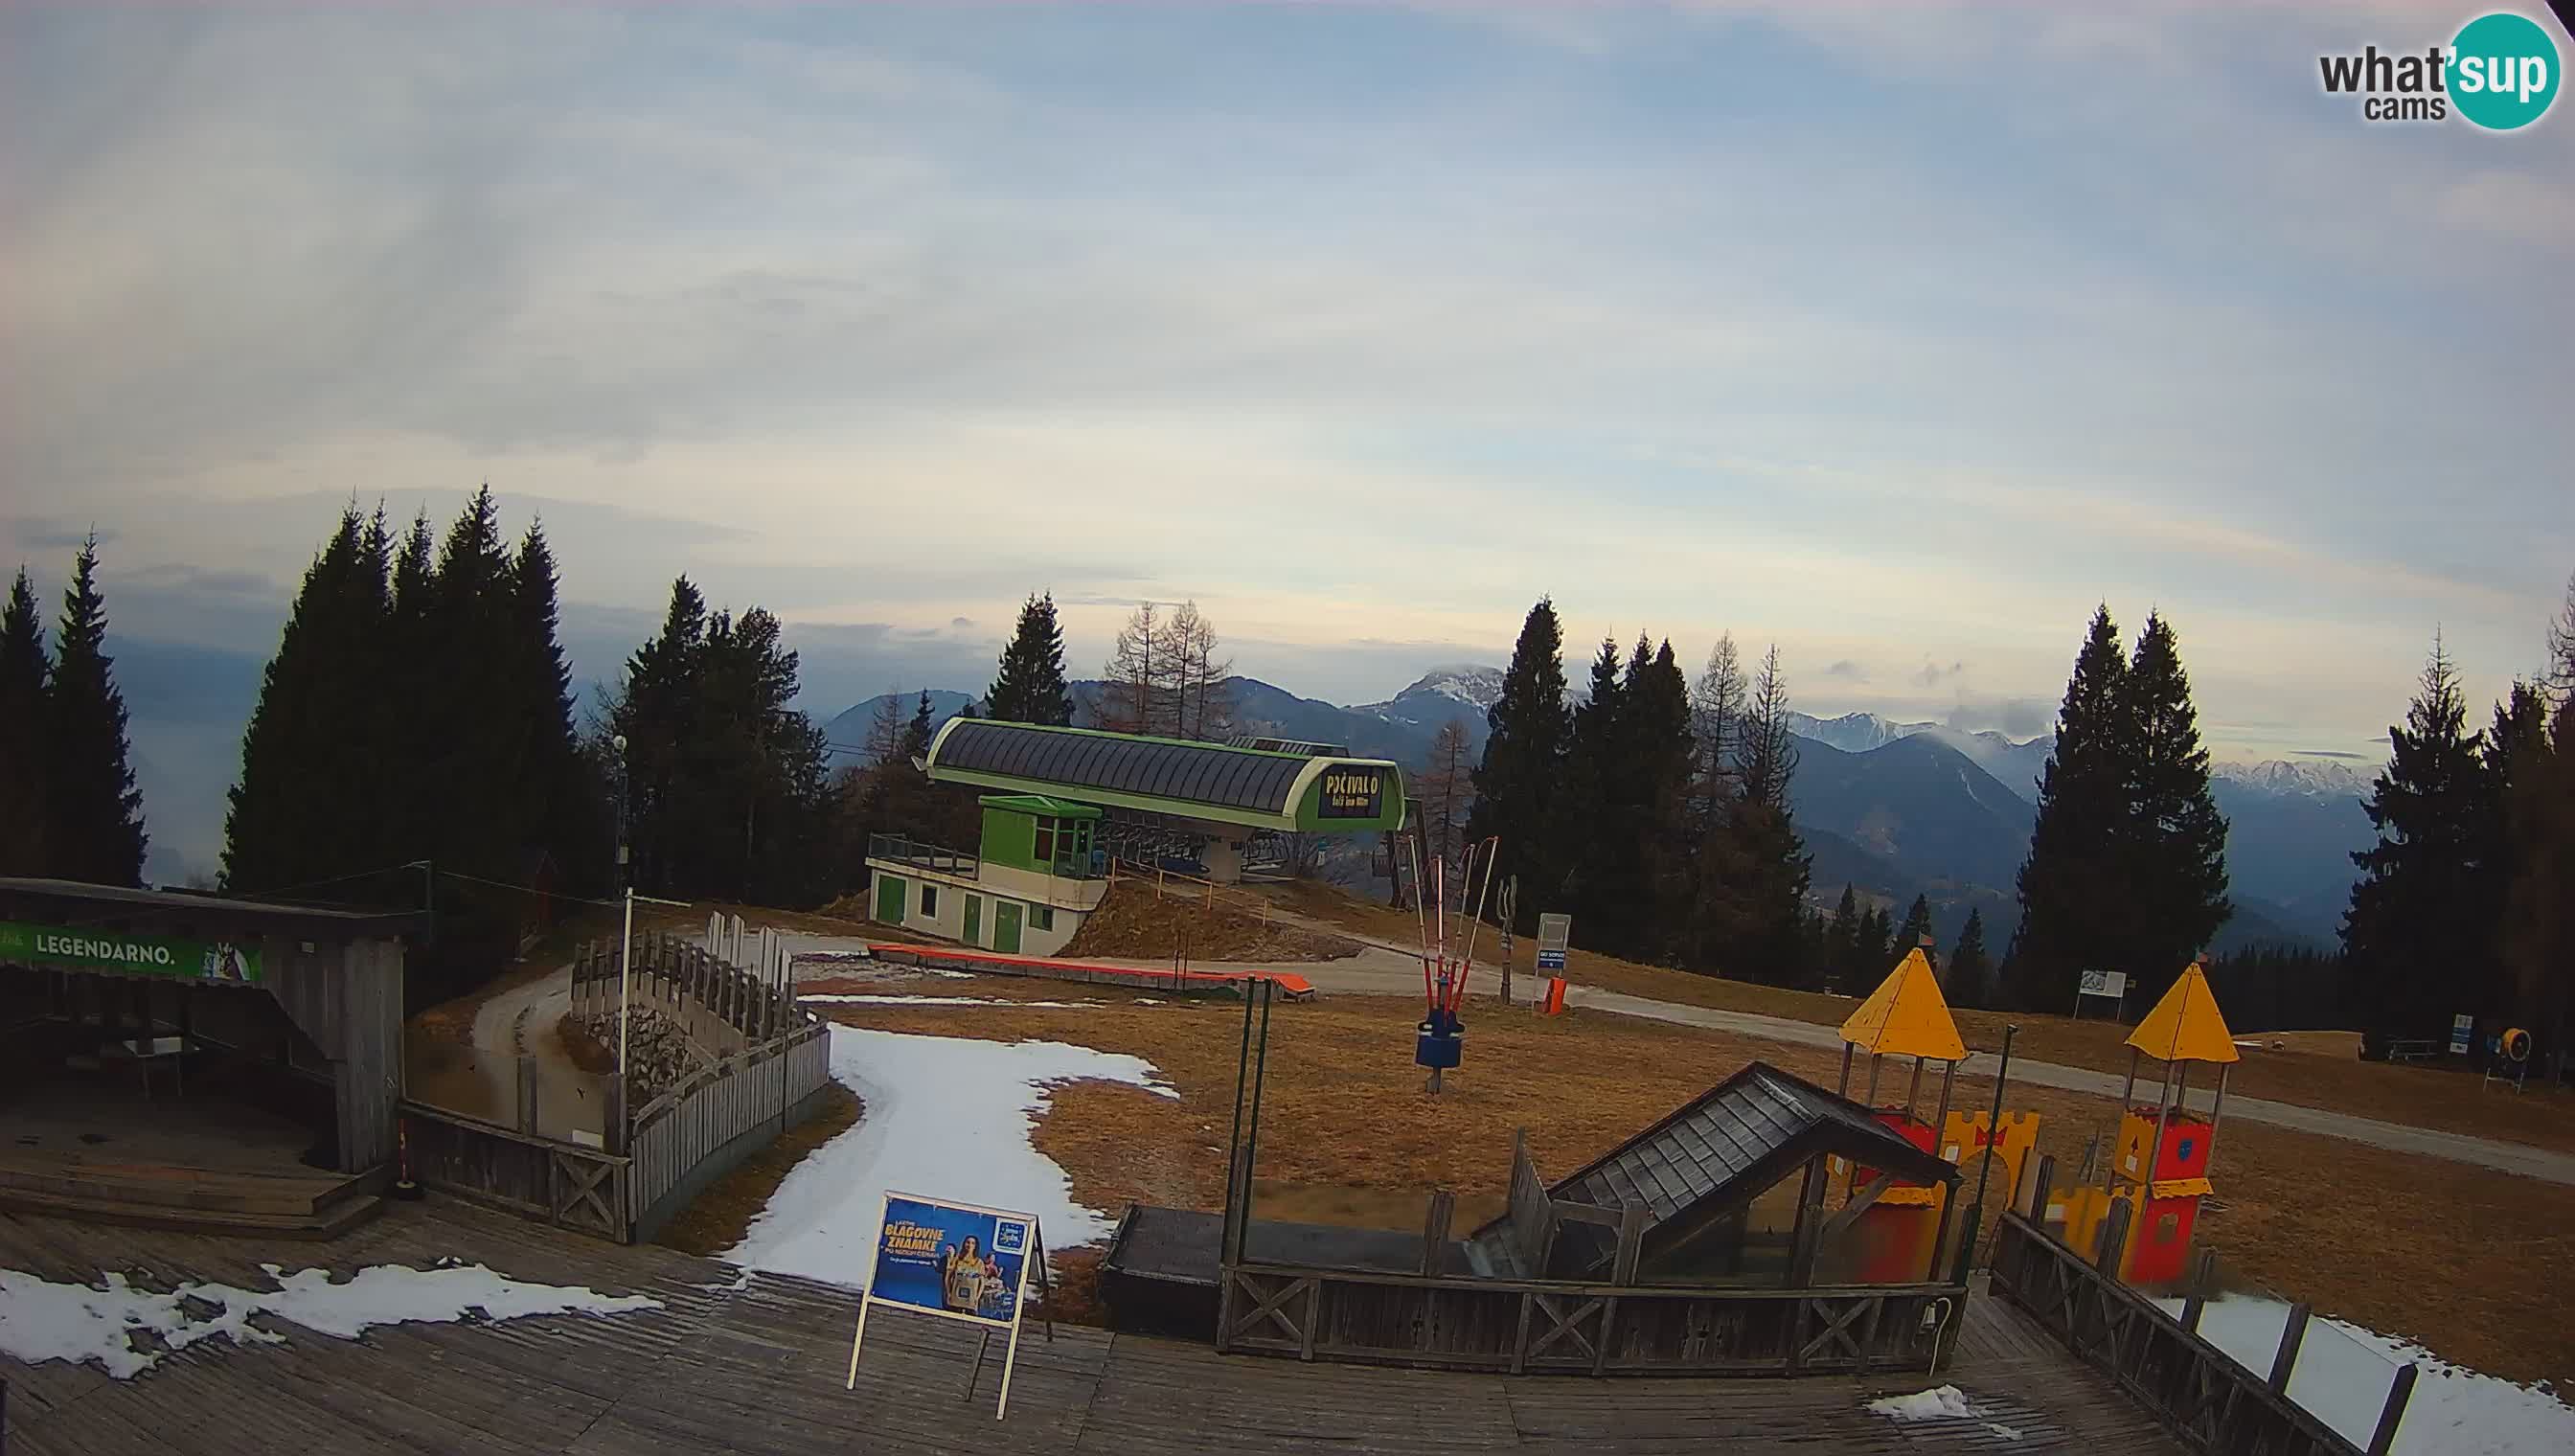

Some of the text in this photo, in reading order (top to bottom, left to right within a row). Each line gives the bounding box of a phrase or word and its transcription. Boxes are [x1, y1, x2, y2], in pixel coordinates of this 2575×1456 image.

[36, 934, 175, 965] LEGENDARNO.
[885, 1223, 945, 1241] BLAGOVNE
[887, 1236, 937, 1252] ZNAMKE
